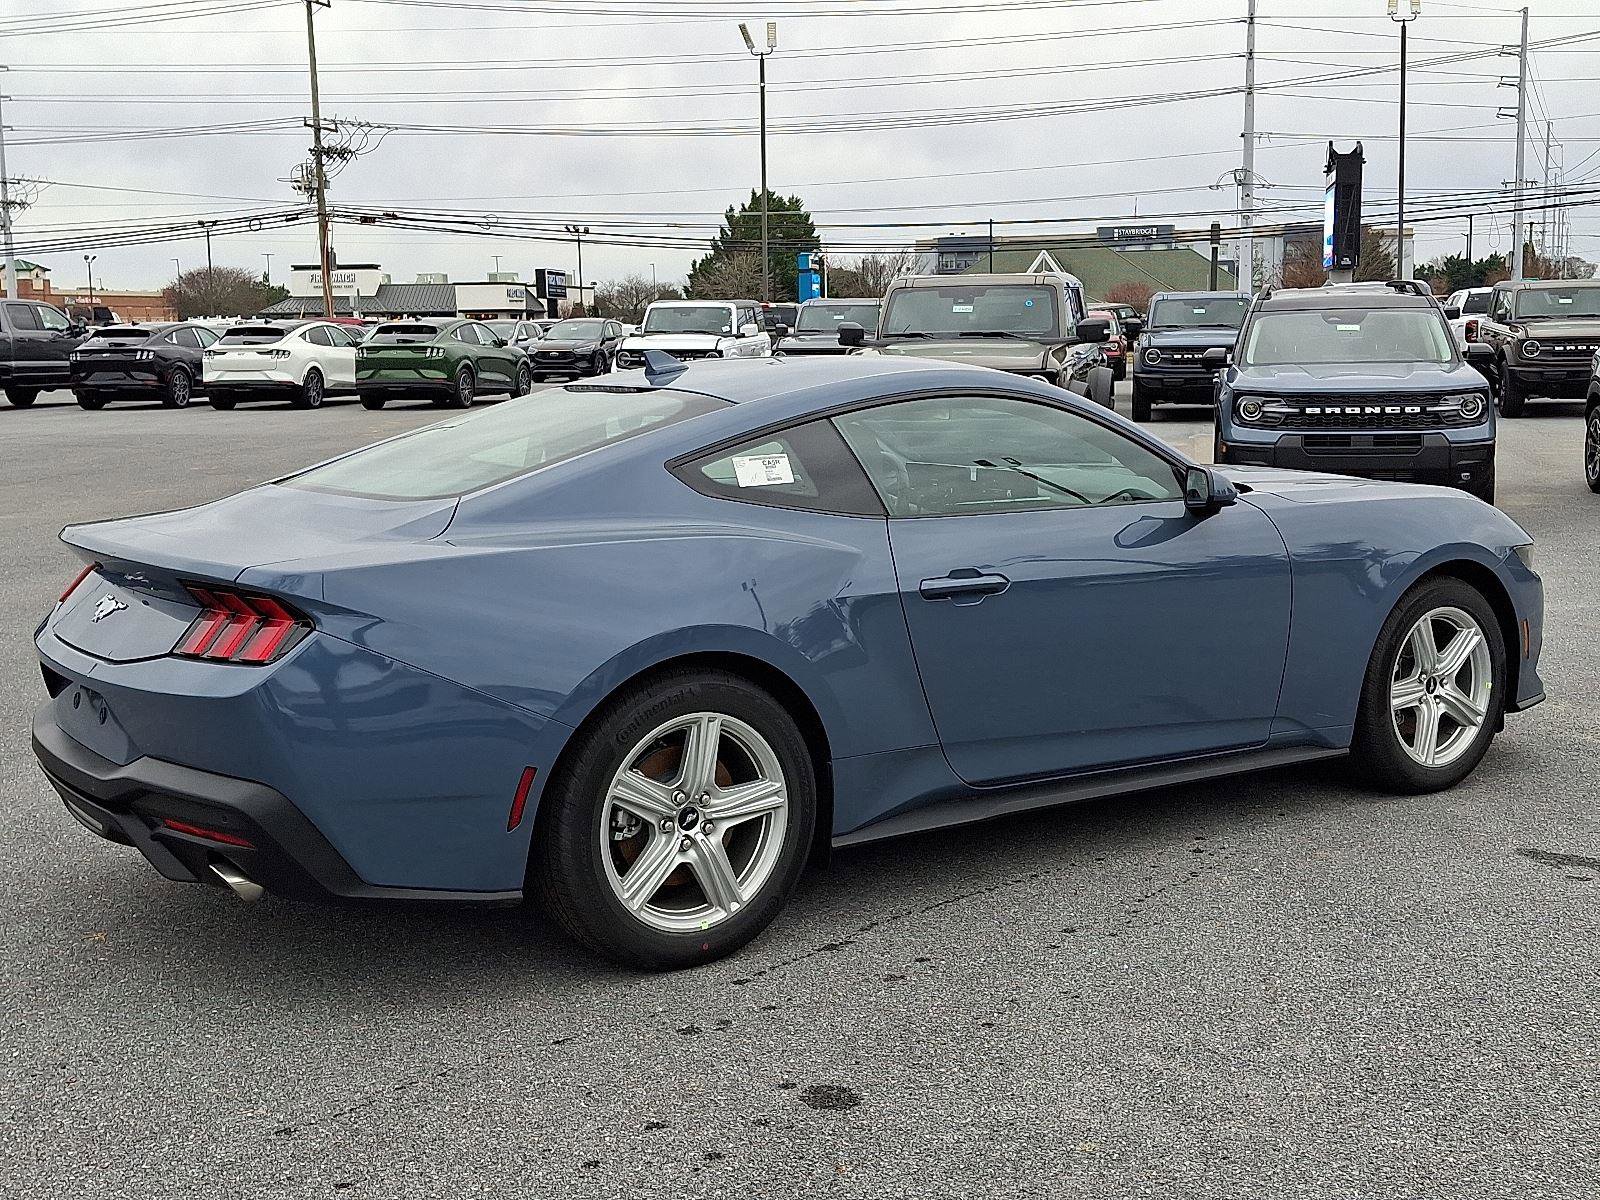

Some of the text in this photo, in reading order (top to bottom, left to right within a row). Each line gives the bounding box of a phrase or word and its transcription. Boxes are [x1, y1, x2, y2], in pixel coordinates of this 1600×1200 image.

[1118, 228, 1152, 236] STAYBRIDGE
[331, 272, 356, 283] WATCH
[1305, 406, 1421, 414] BRONCO
